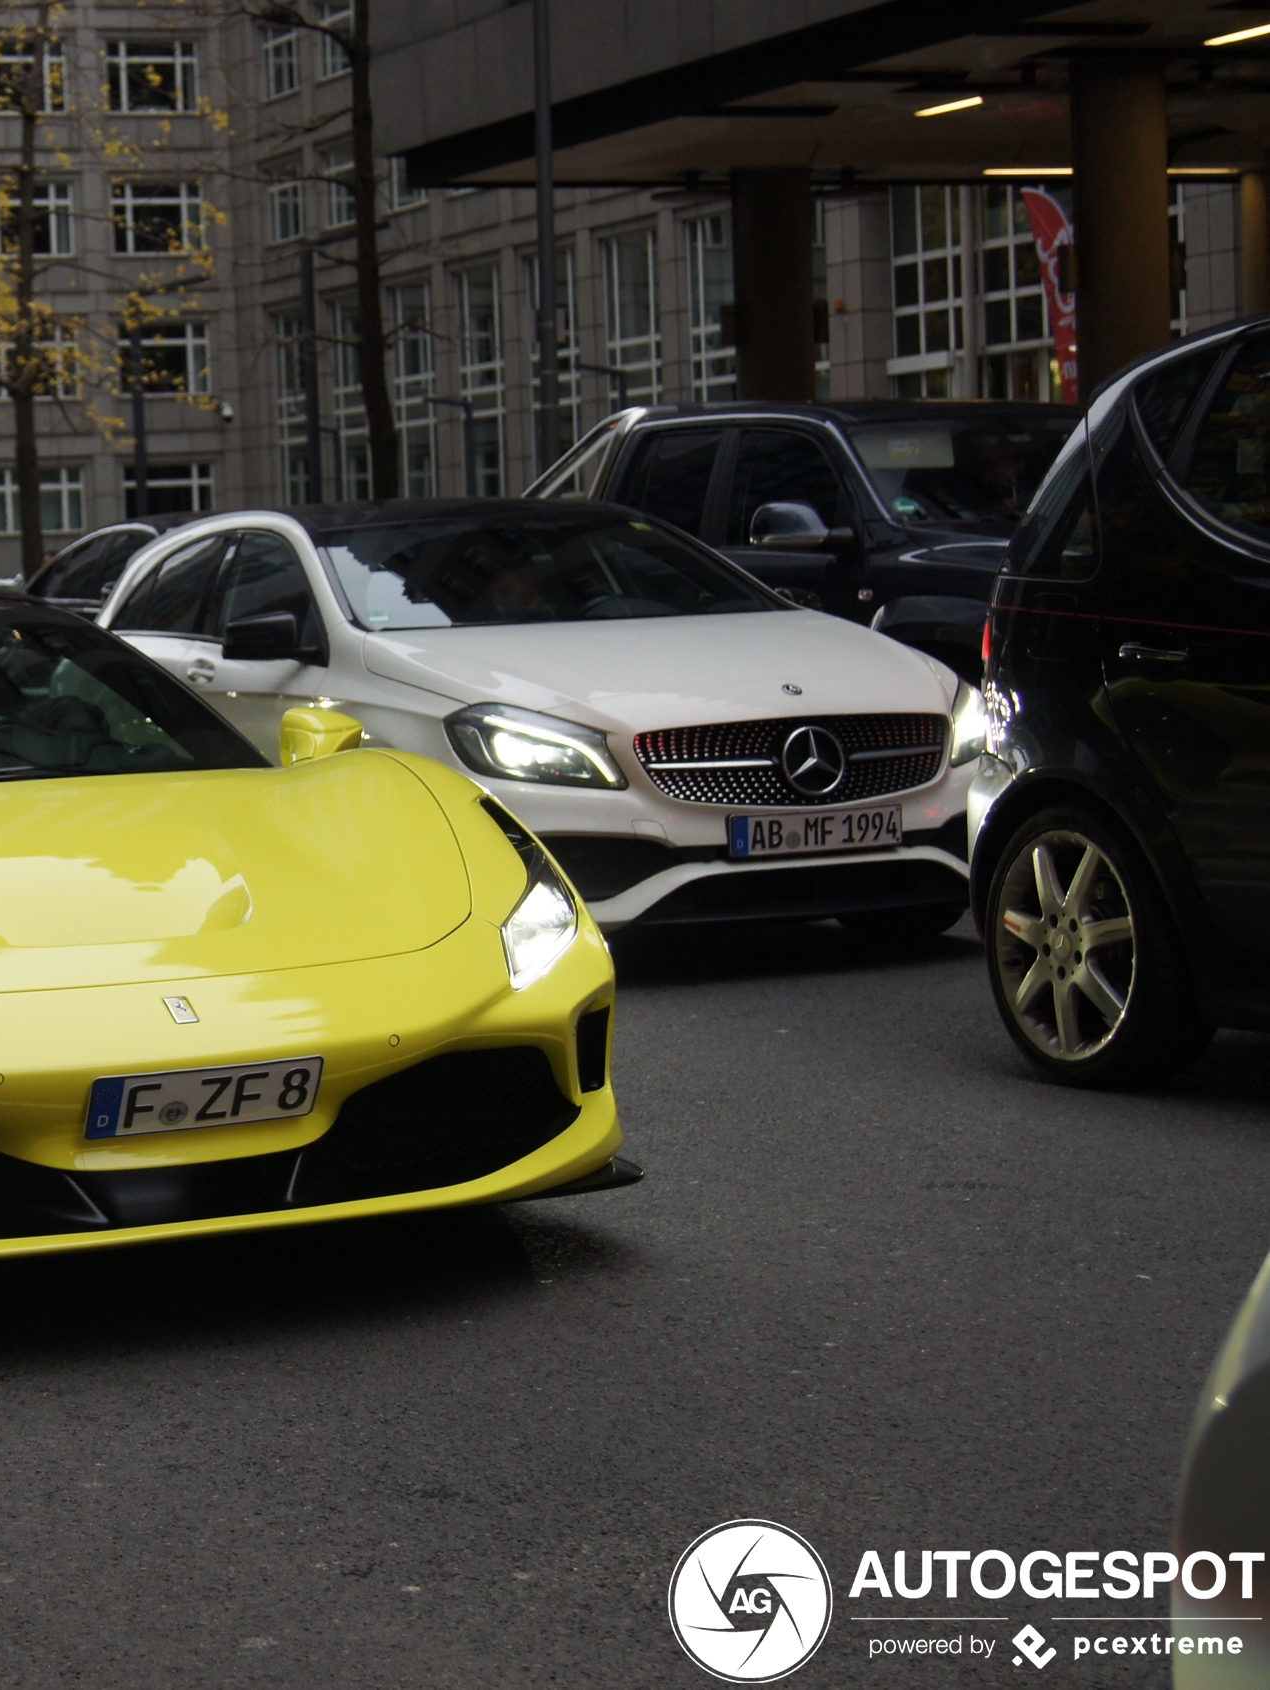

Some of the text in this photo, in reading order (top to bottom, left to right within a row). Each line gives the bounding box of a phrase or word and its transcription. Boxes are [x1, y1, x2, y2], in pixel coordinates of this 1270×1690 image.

[751, 810, 898, 850] AB MF 1994
[736, 839, 744, 850] D
[123, 1067, 311, 1129] F ZF 8
[96, 1114, 110, 1129] D
